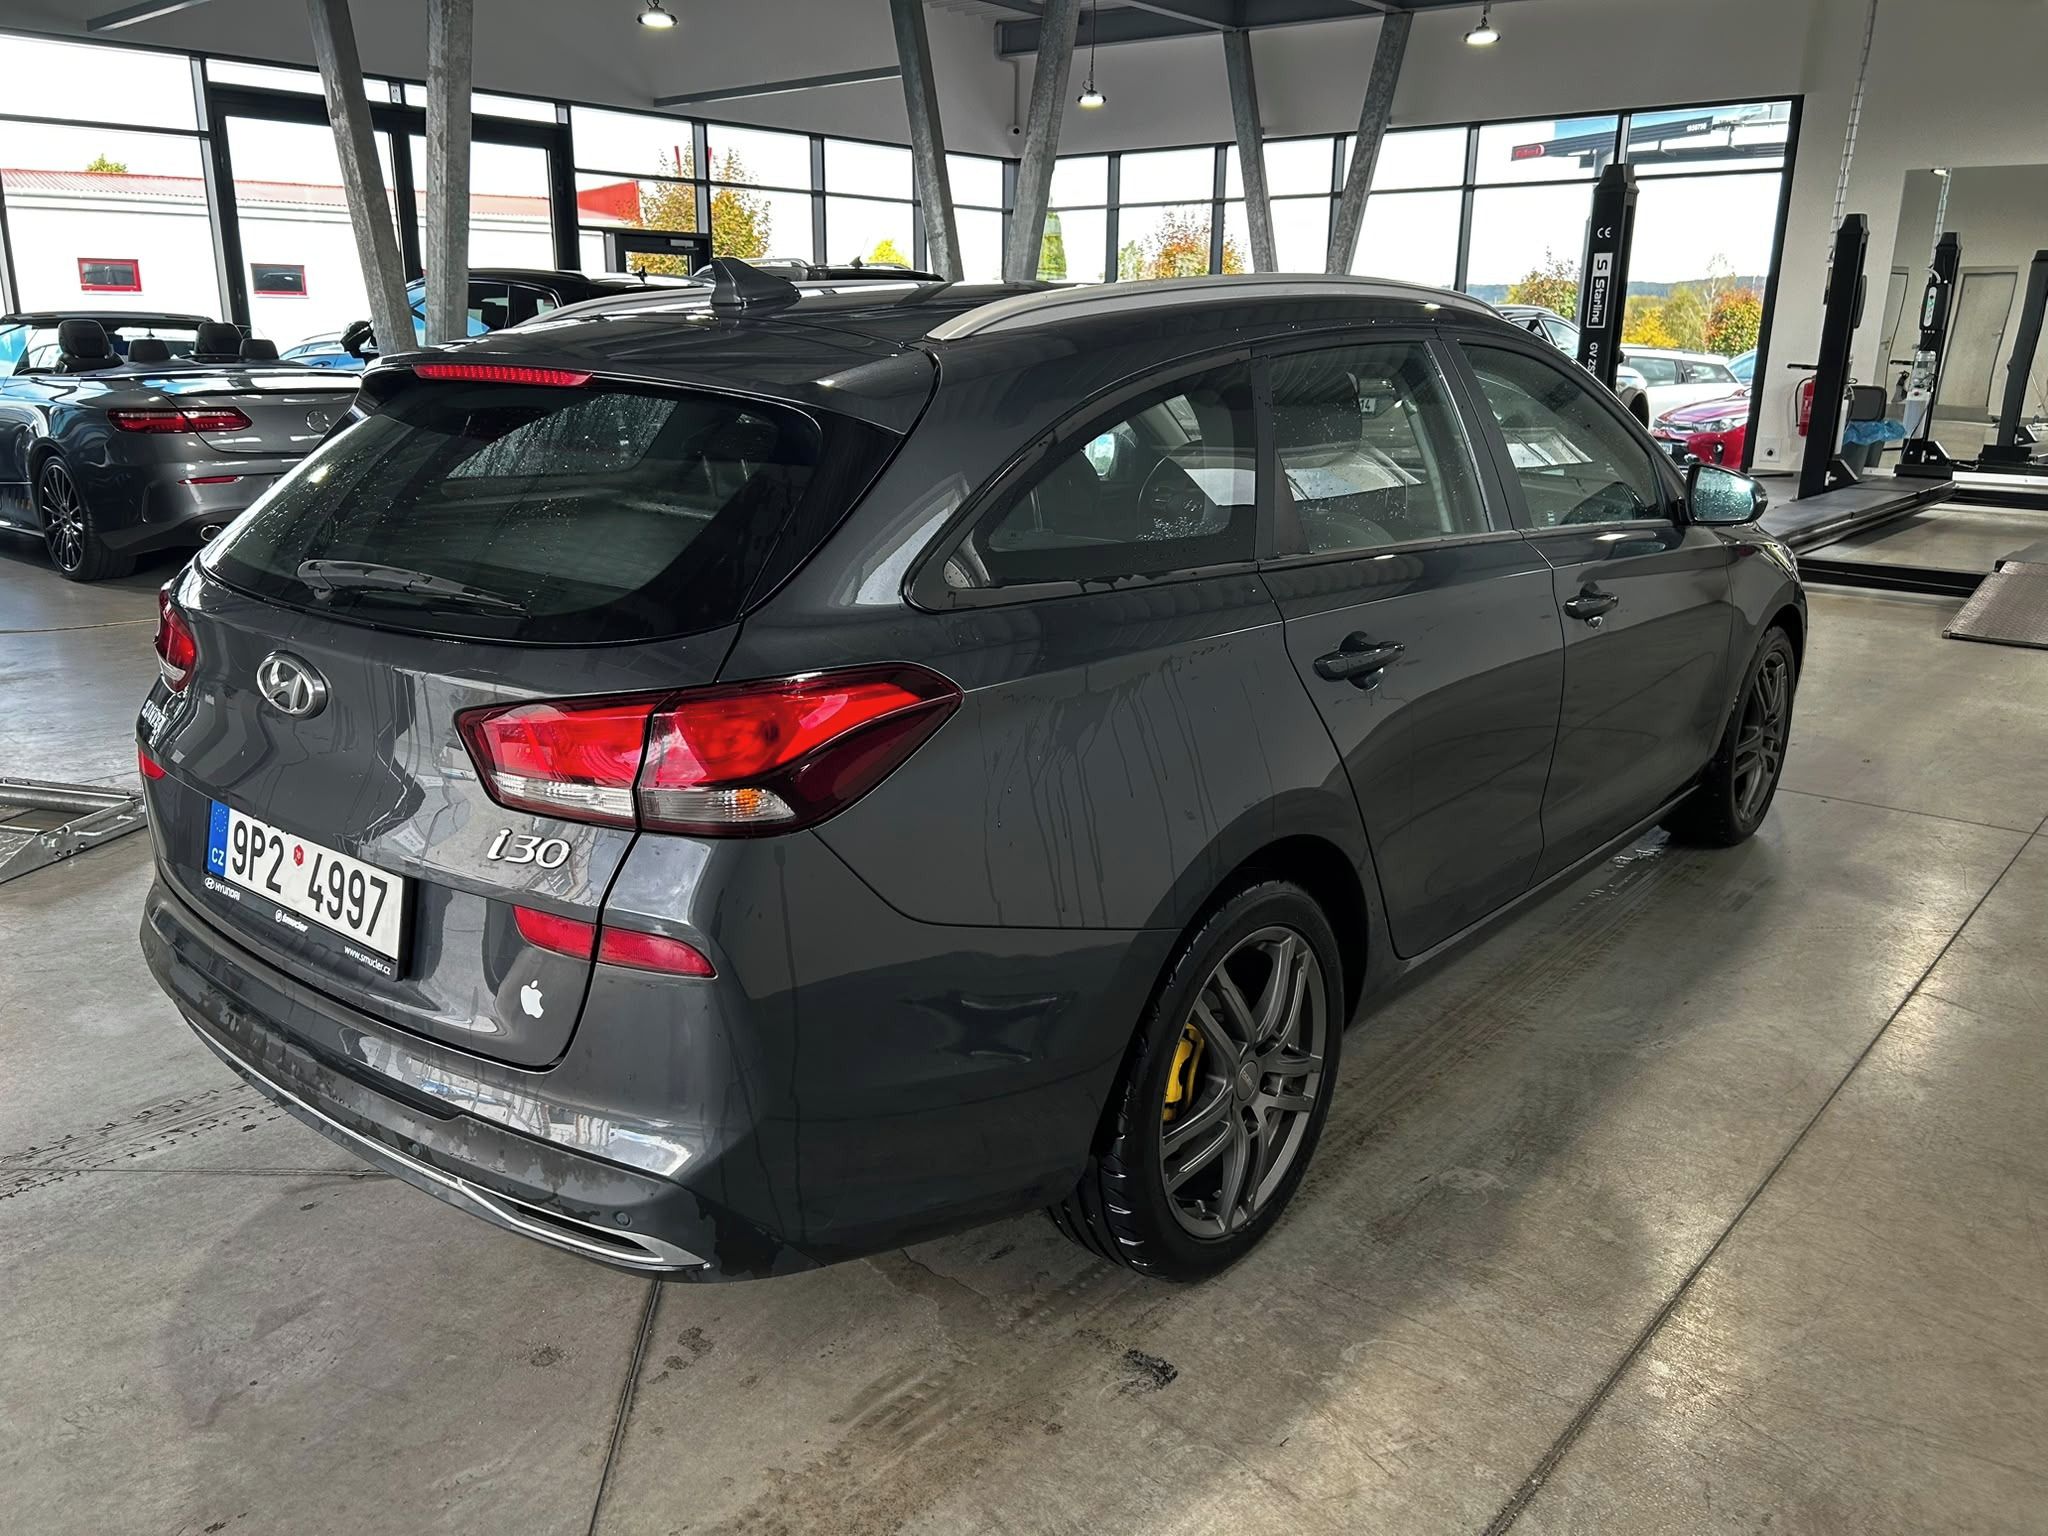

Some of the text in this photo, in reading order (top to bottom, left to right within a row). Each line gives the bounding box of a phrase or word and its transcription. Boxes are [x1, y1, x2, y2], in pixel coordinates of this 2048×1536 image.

[1591, 279, 1605, 323] Starline
[1589, 342, 1599, 357] GV
[211, 847, 224, 866] CZ
[487, 828, 572, 869] i30
[214, 882, 241, 901] HYUNDAI
[232, 820, 388, 937] 9P2 4997
[344, 945, 391, 975] www.smucler.cz
